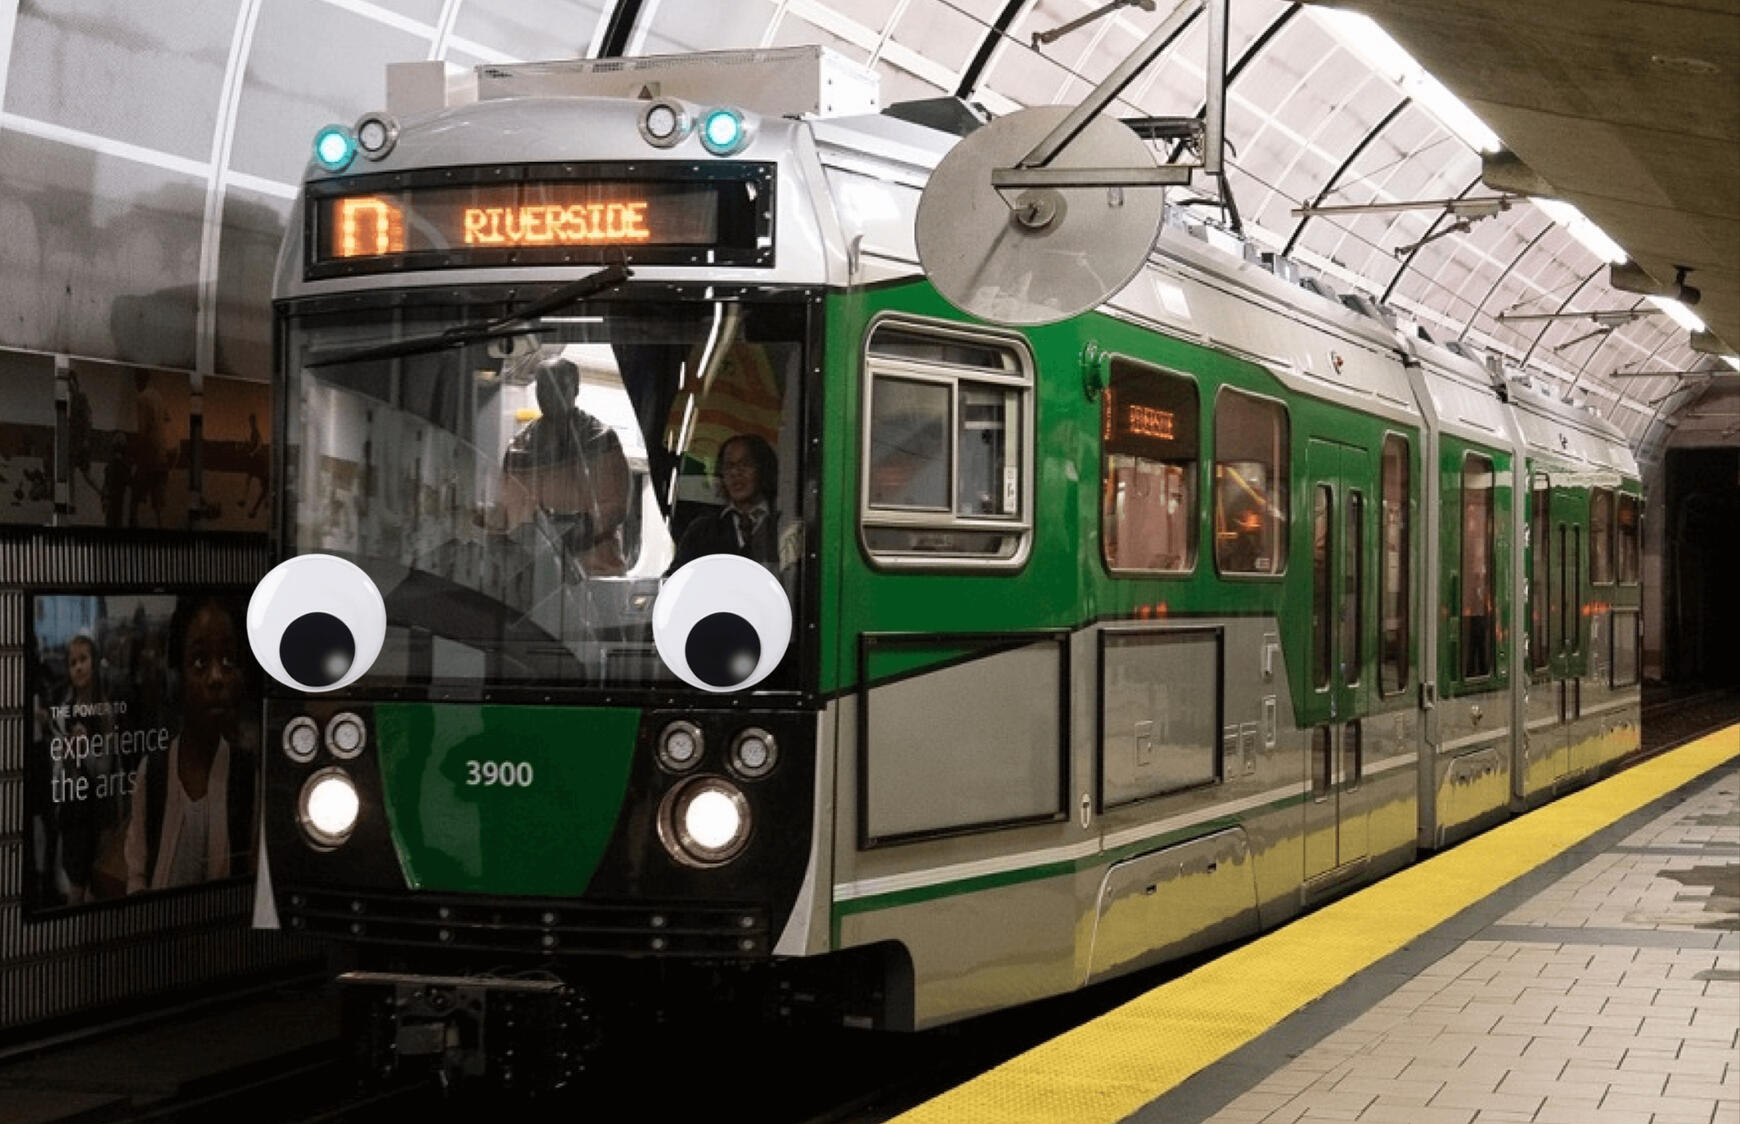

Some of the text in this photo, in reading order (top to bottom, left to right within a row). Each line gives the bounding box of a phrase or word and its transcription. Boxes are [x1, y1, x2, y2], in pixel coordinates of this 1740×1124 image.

[464, 202, 651, 244] RIVERSIDE
[50, 700, 128, 719] THE POWER TO
[50, 724, 169, 768] experience
[51, 768, 138, 803] the arts
[466, 760, 533, 787] 3900
